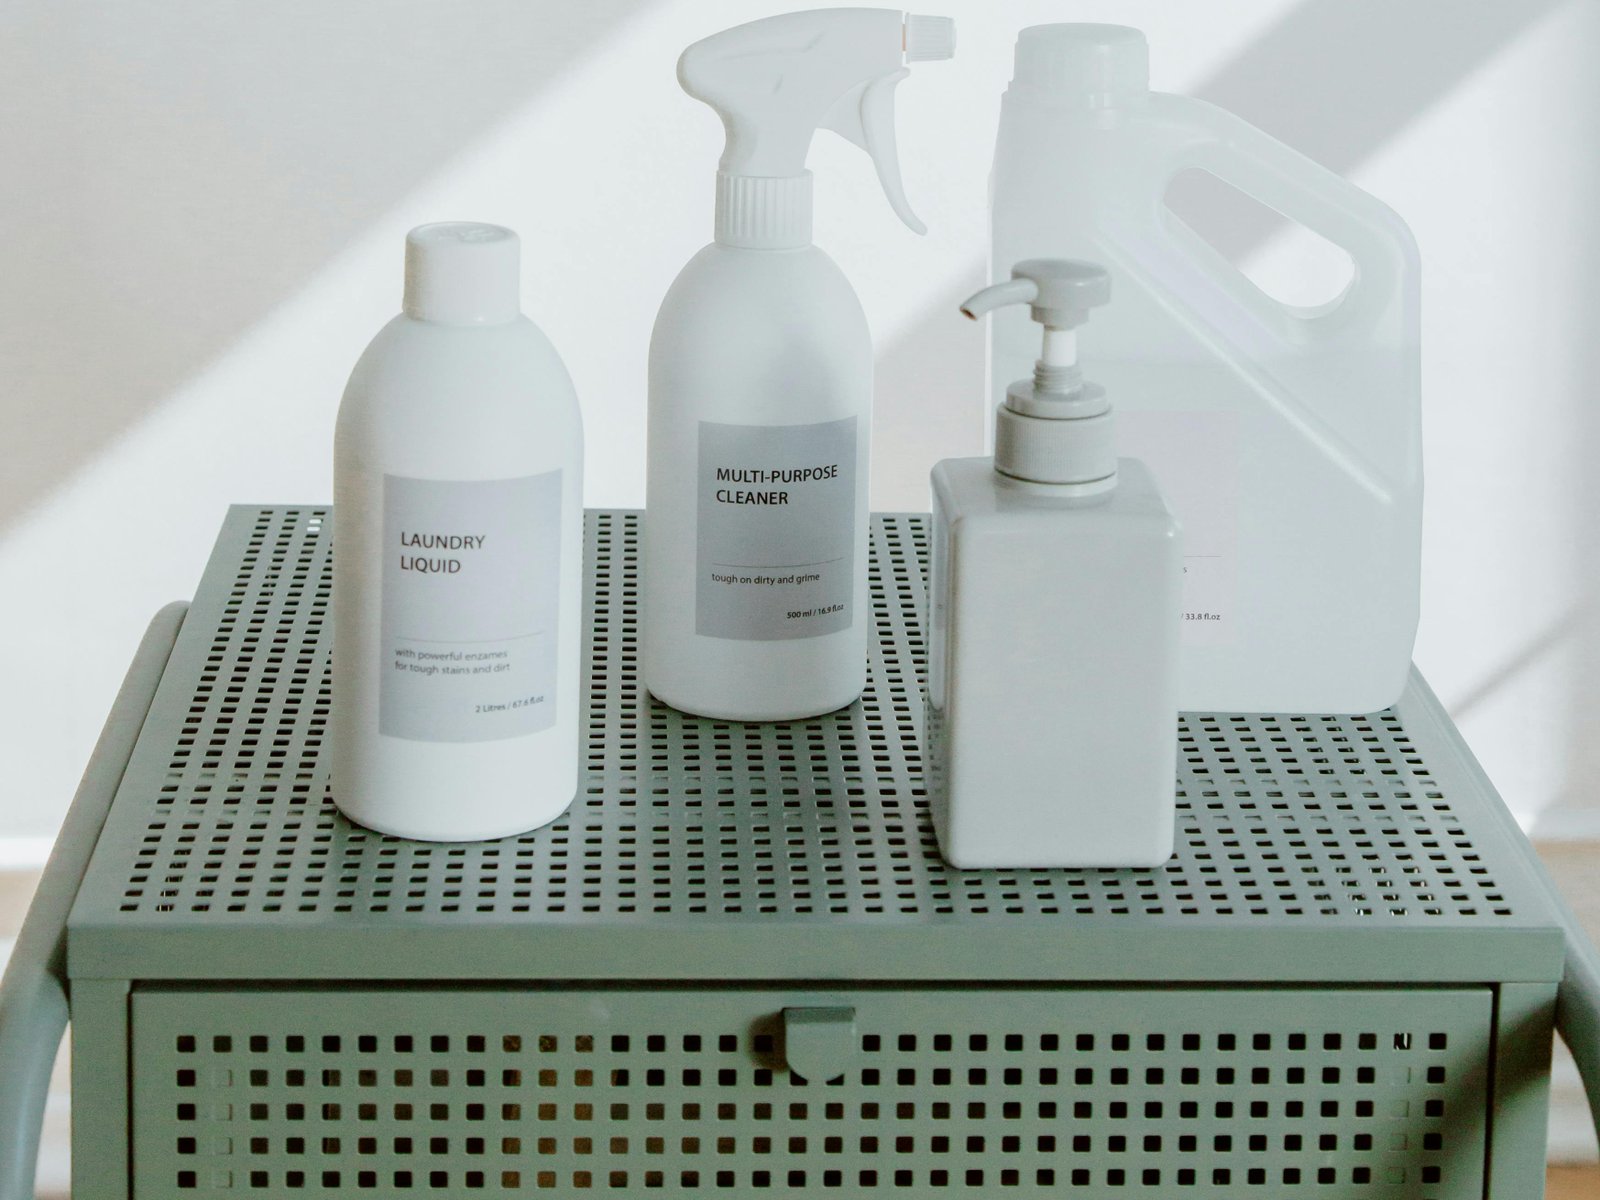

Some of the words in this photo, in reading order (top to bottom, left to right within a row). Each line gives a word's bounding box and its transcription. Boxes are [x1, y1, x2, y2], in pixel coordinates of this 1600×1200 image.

[717, 465, 838, 483] MULTI-PURPOSE
[716, 489, 788, 505] CLEANER
[401, 531, 486, 550] LAUNDRY
[401, 555, 461, 574] LIQUID
[712, 573, 738, 584] tough
[740, 576, 752, 584] on
[754, 575, 775, 585] dirty
[778, 574, 794, 584] and
[796, 573, 820, 584] grime
[787, 611, 801, 619] 500
[803, 609, 812, 617] ml
[818, 606, 832, 615] 16.9
[395, 650, 416, 659] with
[418, 651, 462, 662] powerful
[395, 661, 407, 671] for
[409, 663, 438, 676] tough
[441, 666, 470, 675] stains
[472, 664, 491, 674] and
[493, 662, 510, 672] dirt
[475, 705, 481, 713] 2
[483, 703, 506, 713] Litres
